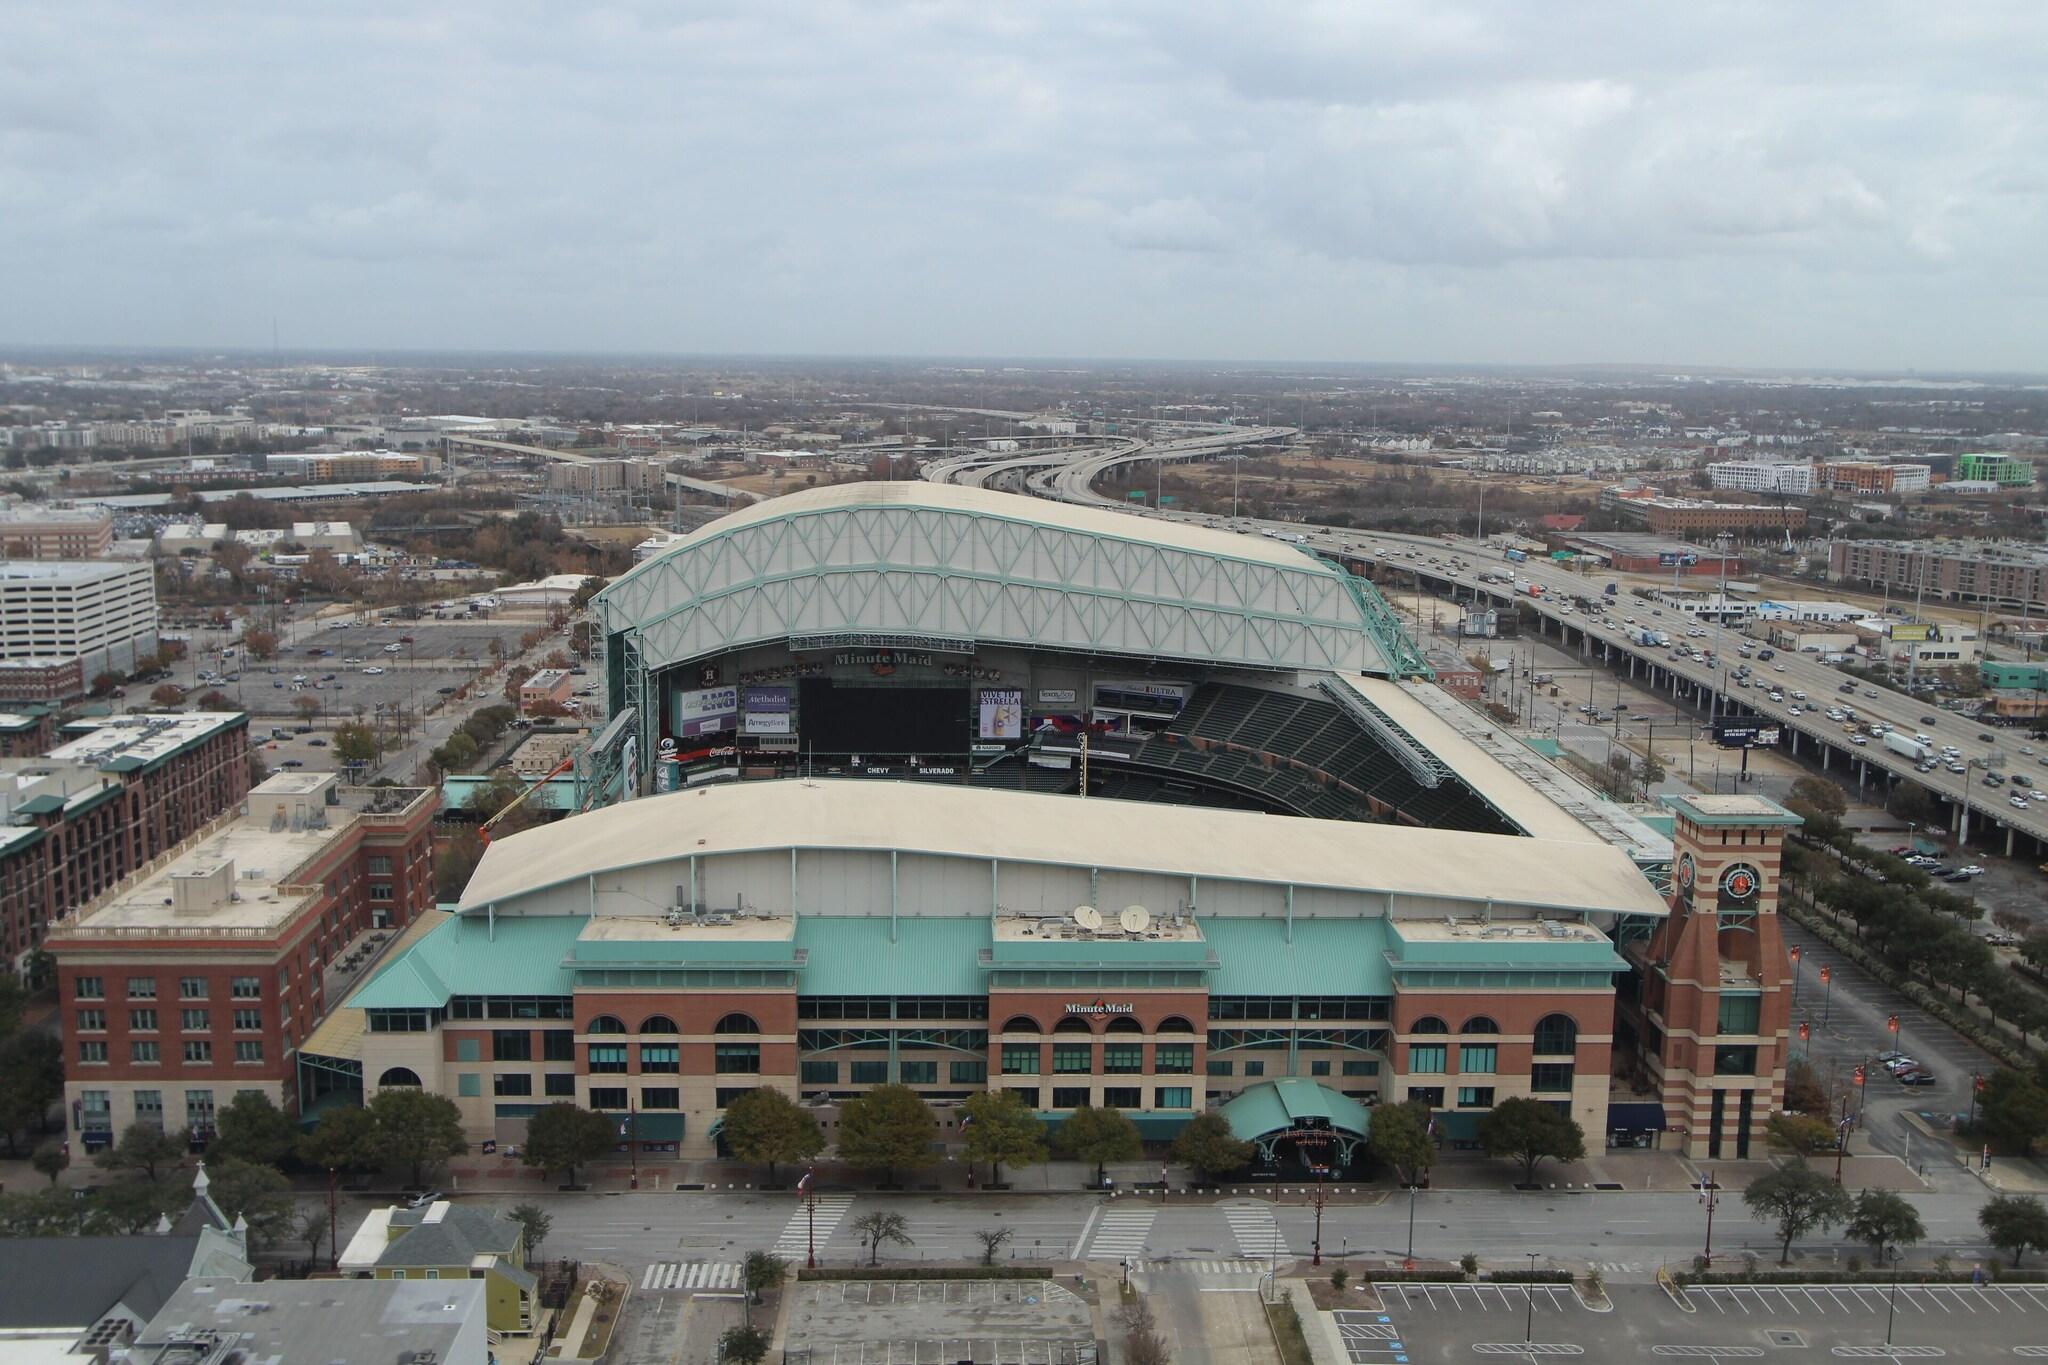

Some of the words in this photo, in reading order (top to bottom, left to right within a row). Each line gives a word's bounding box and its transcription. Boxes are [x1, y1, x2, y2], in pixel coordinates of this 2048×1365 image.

[835, 652, 890, 665] Minute
[893, 652, 932, 666] Maid
[1151, 686, 1176, 696] ULTRA
[748, 694, 786, 704] Methodist
[980, 697, 1020, 705] ESTRELLA
[1065, 1003, 1104, 1013] Minute
[1105, 1003, 1133, 1013] Maid
